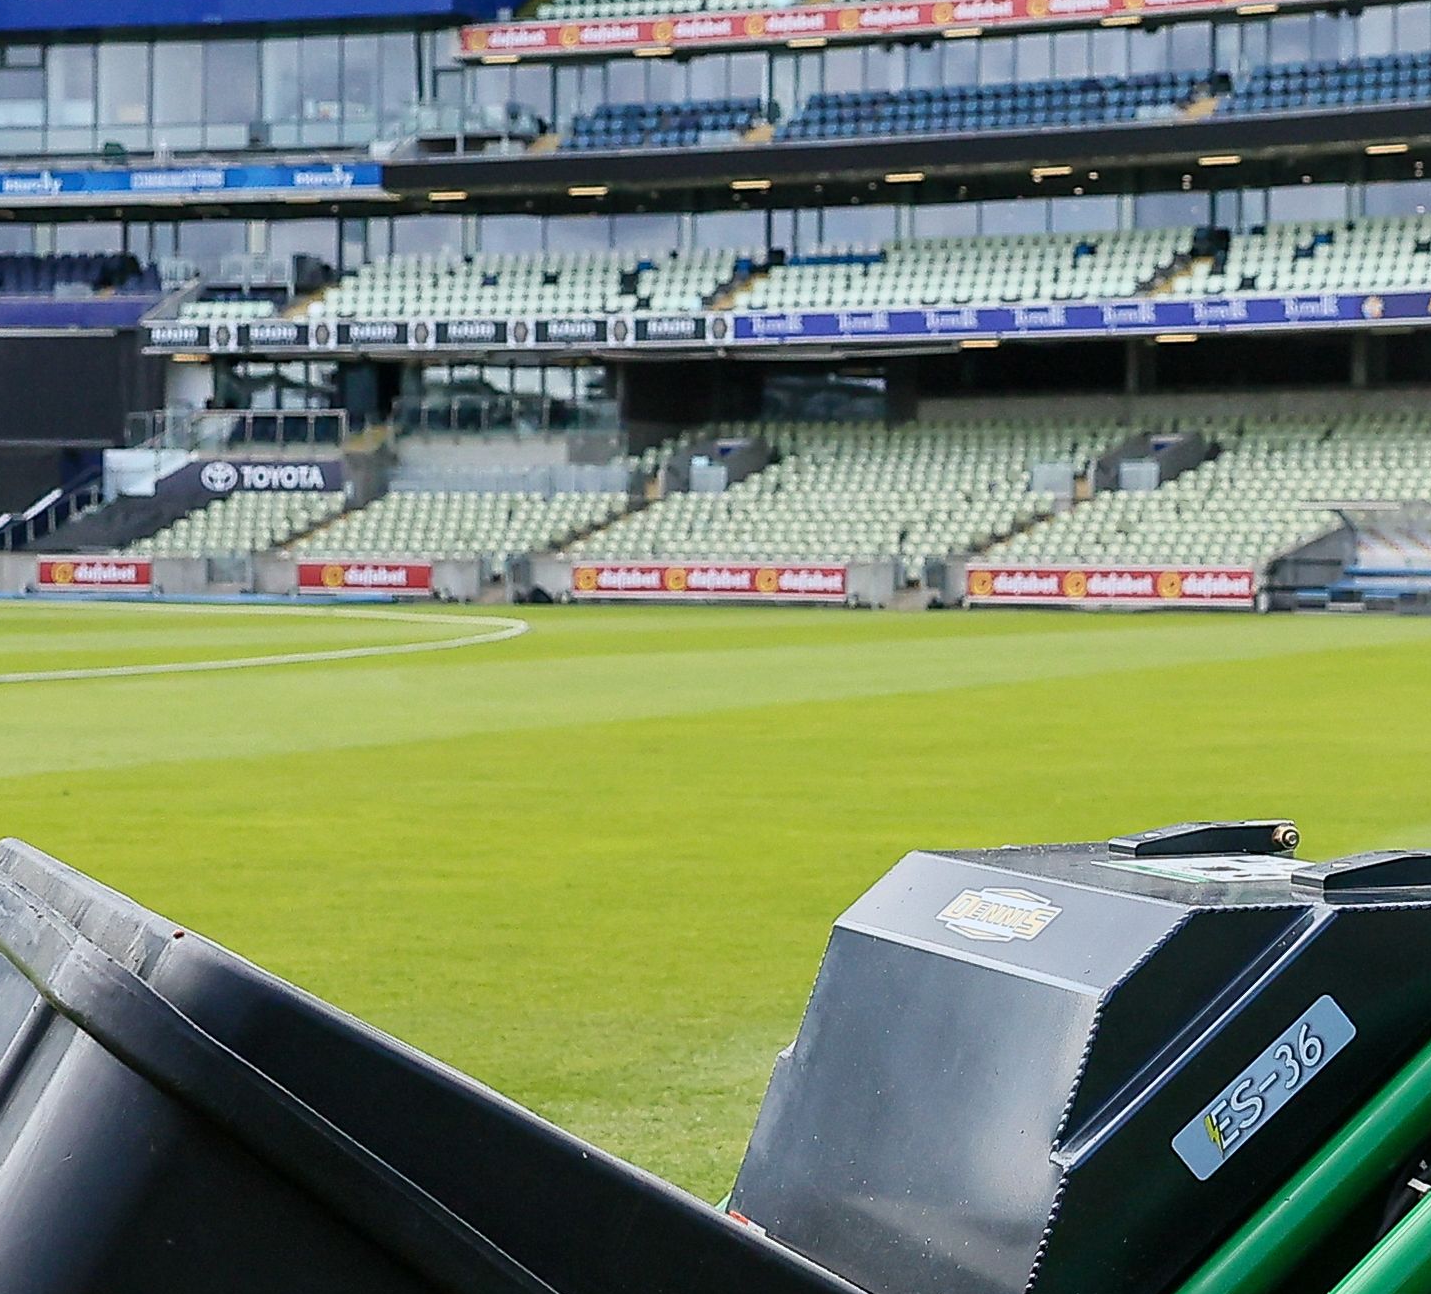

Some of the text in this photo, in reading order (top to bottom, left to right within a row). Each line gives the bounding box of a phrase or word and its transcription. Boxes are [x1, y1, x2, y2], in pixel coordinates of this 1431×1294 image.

[240, 465, 326, 489] TOYOTA
[941, 893, 1058, 936] DENNIS
[1204, 1023, 1324, 1156] ES-36
